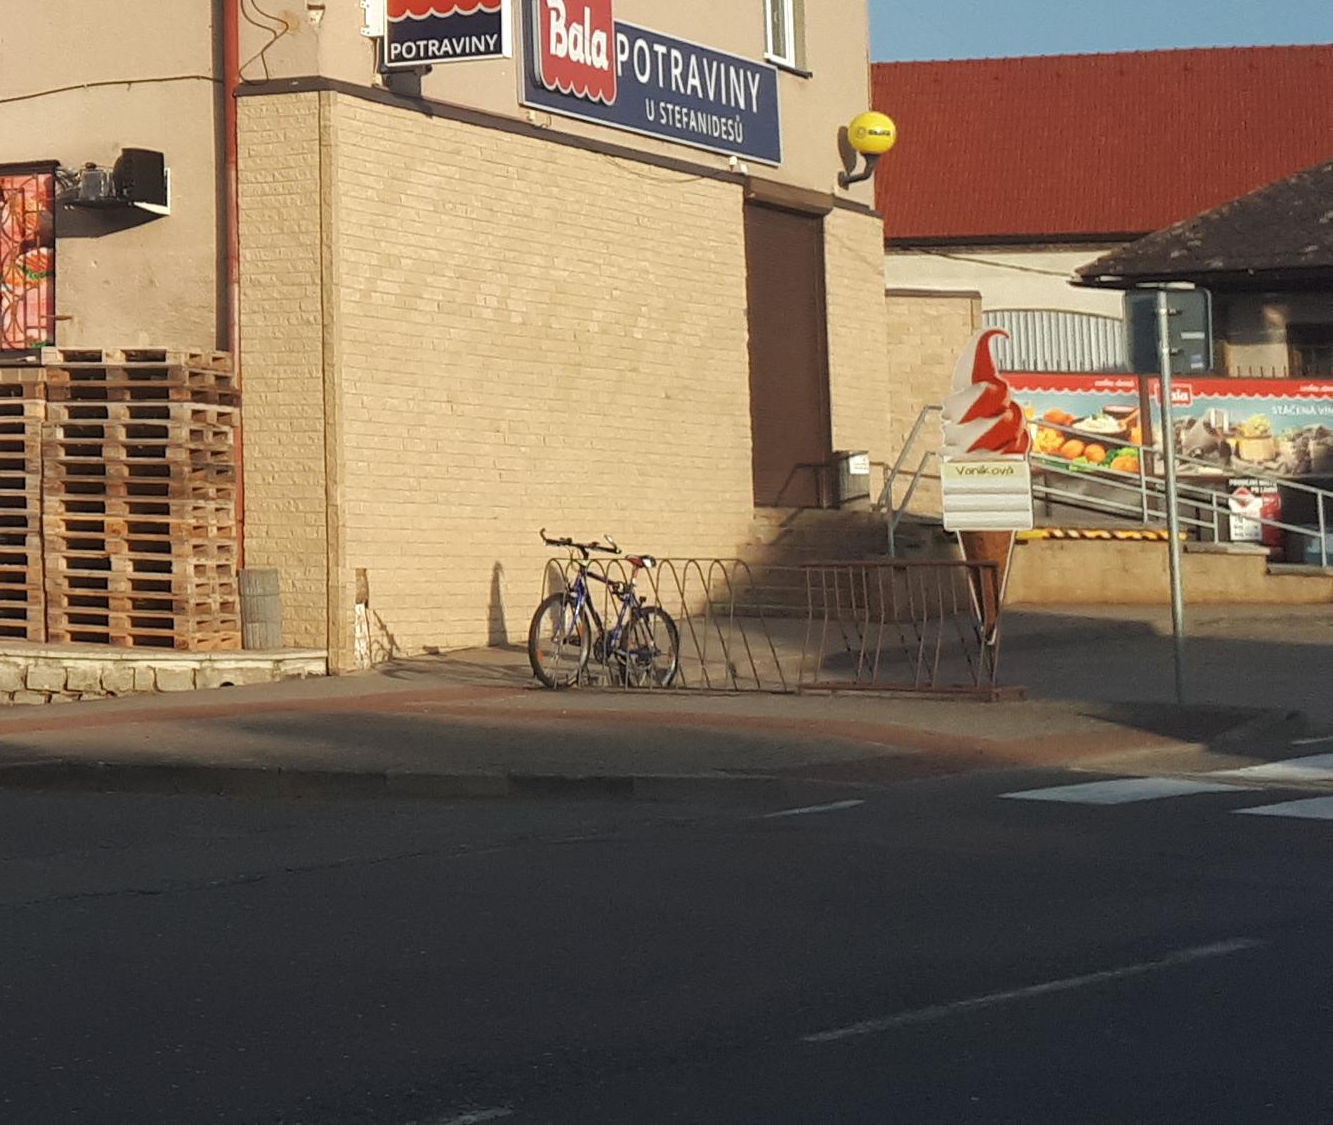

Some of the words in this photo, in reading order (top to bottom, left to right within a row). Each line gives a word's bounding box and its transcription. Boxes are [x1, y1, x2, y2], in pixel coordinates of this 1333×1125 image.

[390, 34, 498, 60] POTRAVINY
[617, 32, 761, 113] POTRAVINY
[645, 98, 655, 121] U
[660, 102, 743, 144] STEFANIDESŮ
